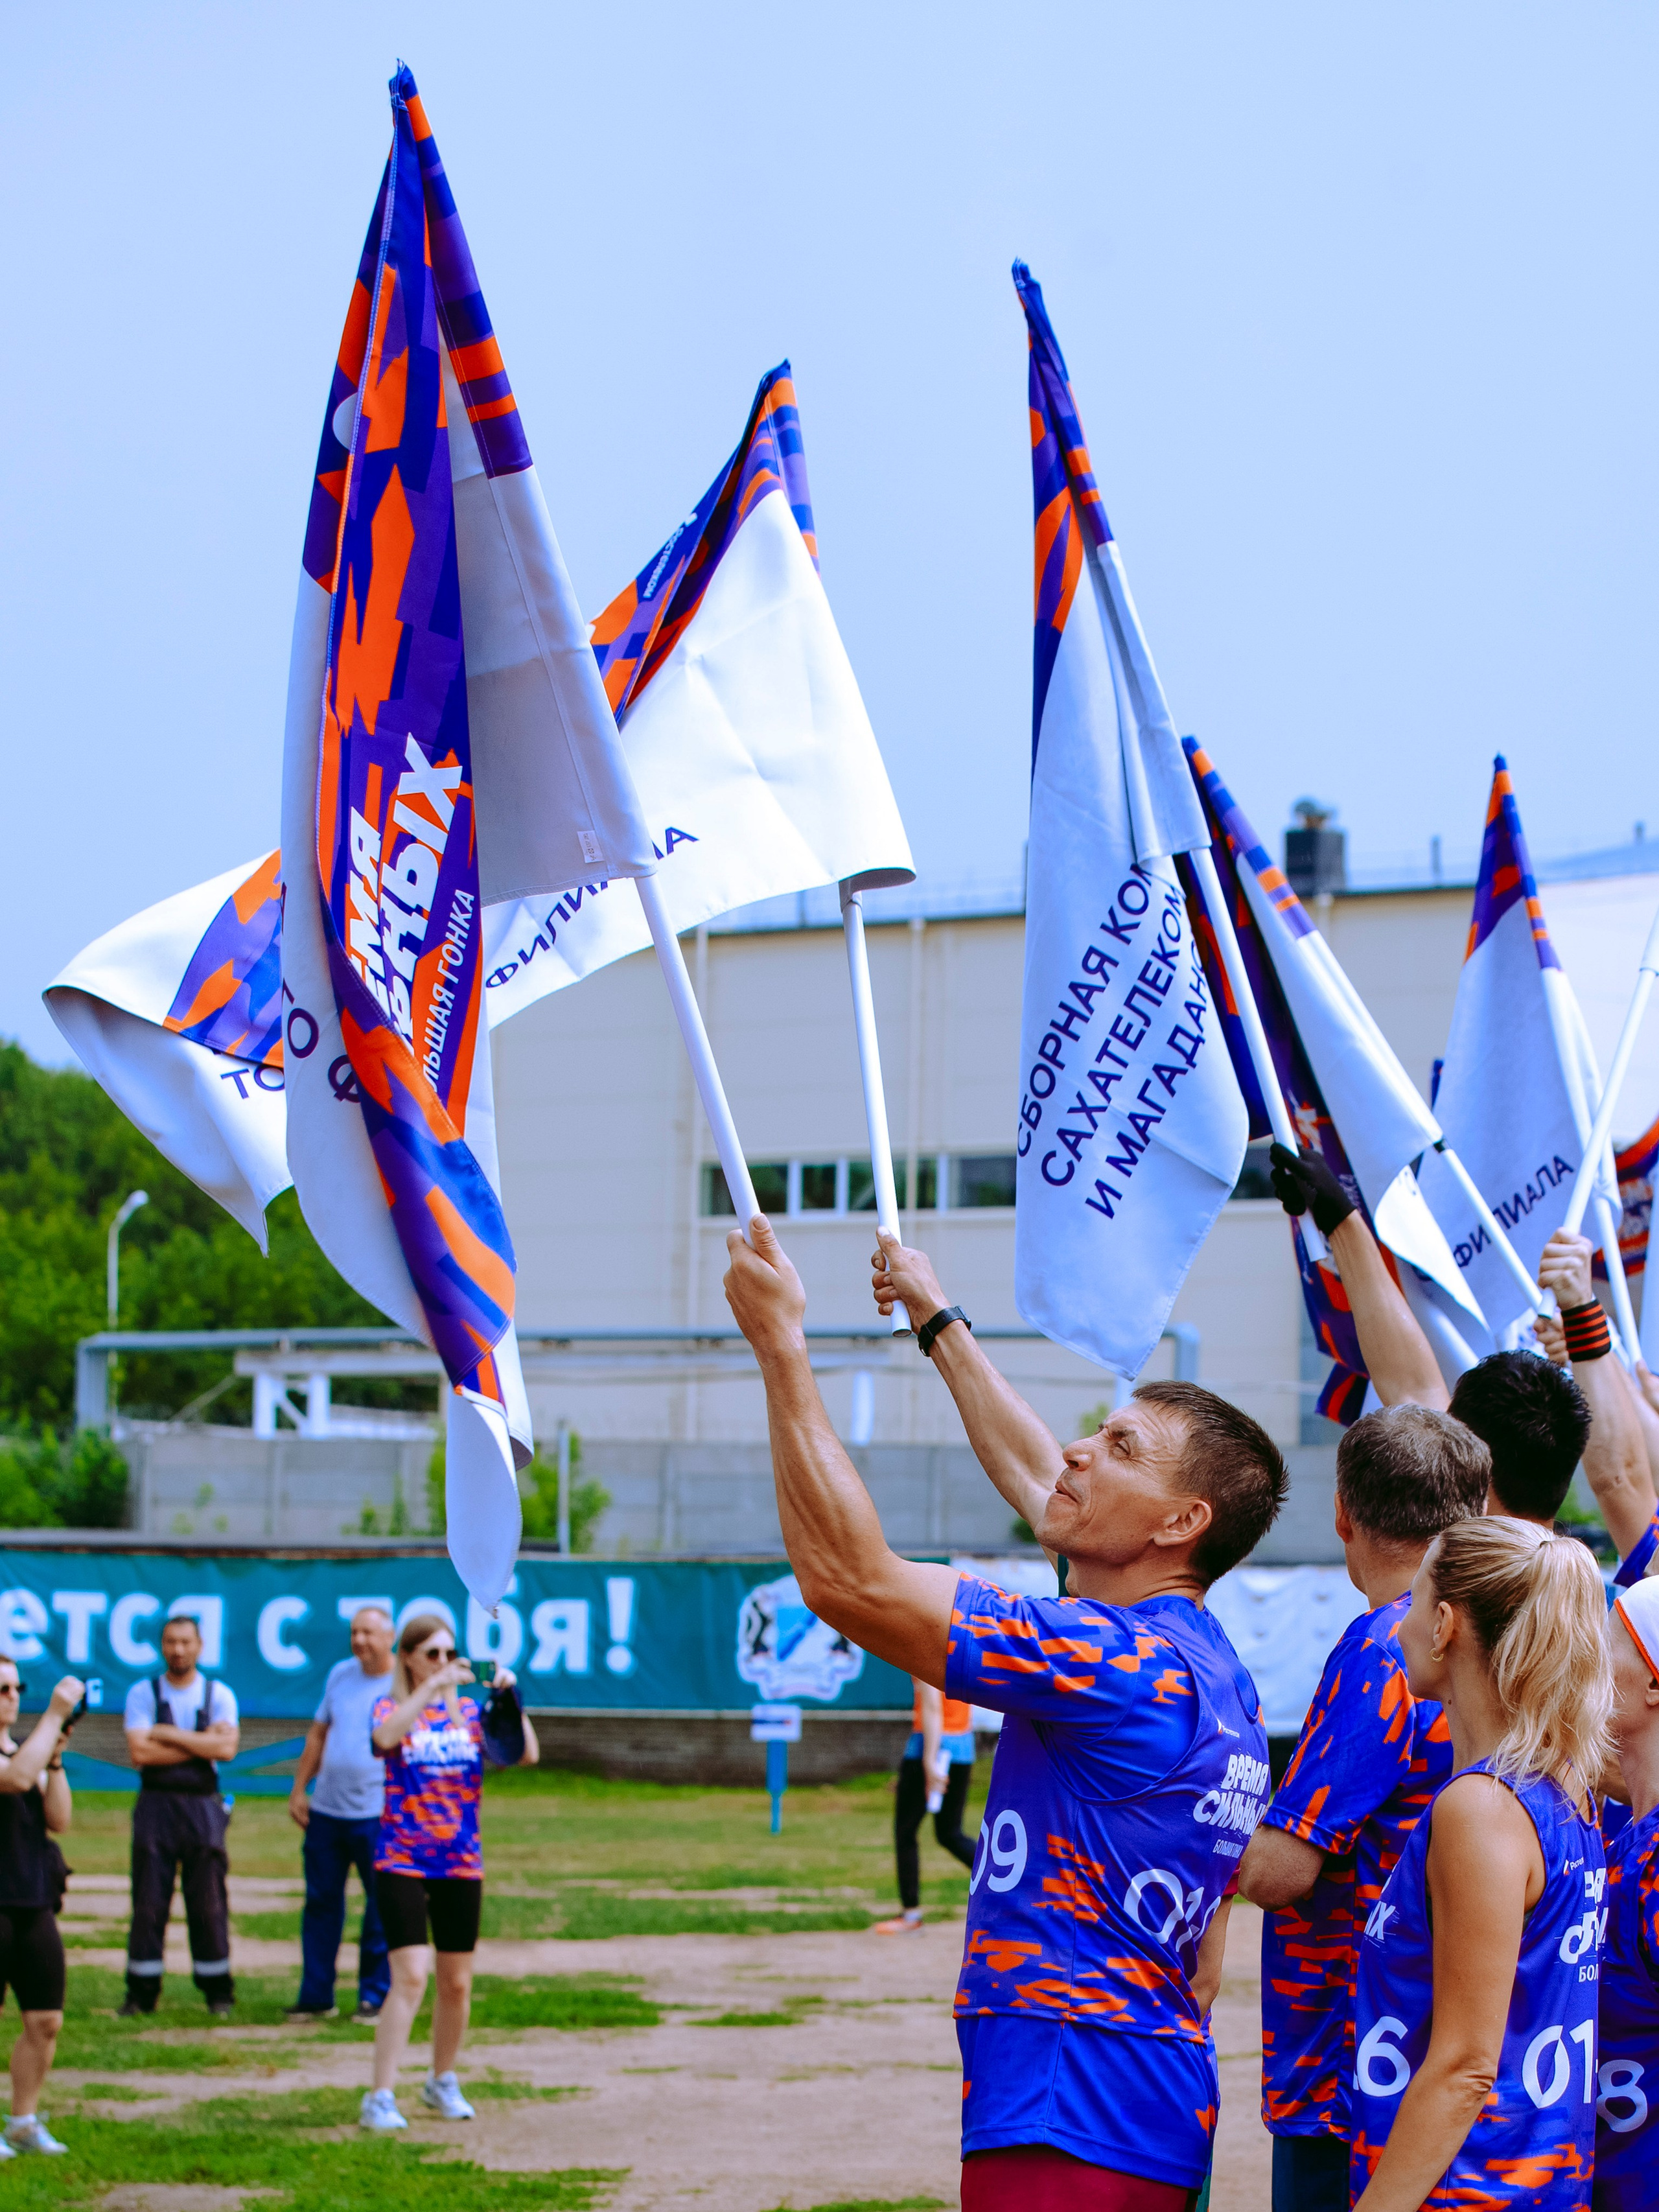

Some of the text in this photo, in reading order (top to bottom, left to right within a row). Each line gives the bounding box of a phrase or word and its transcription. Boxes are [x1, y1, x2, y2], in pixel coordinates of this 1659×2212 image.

[380, 732, 463, 1056] ЬНЫХ
[437, 889, 475, 984] ГОНКА
[485, 827, 699, 988] ФИЛИА
[1017, 945, 1119, 1157] СБОРНАЯ
[1085, 1178, 1122, 1219] И
[1220, 1753, 1270, 1797] ВРЕМЯ
[1353, 2016, 1411, 2097] 6
[1522, 2019, 1597, 2109] 01
